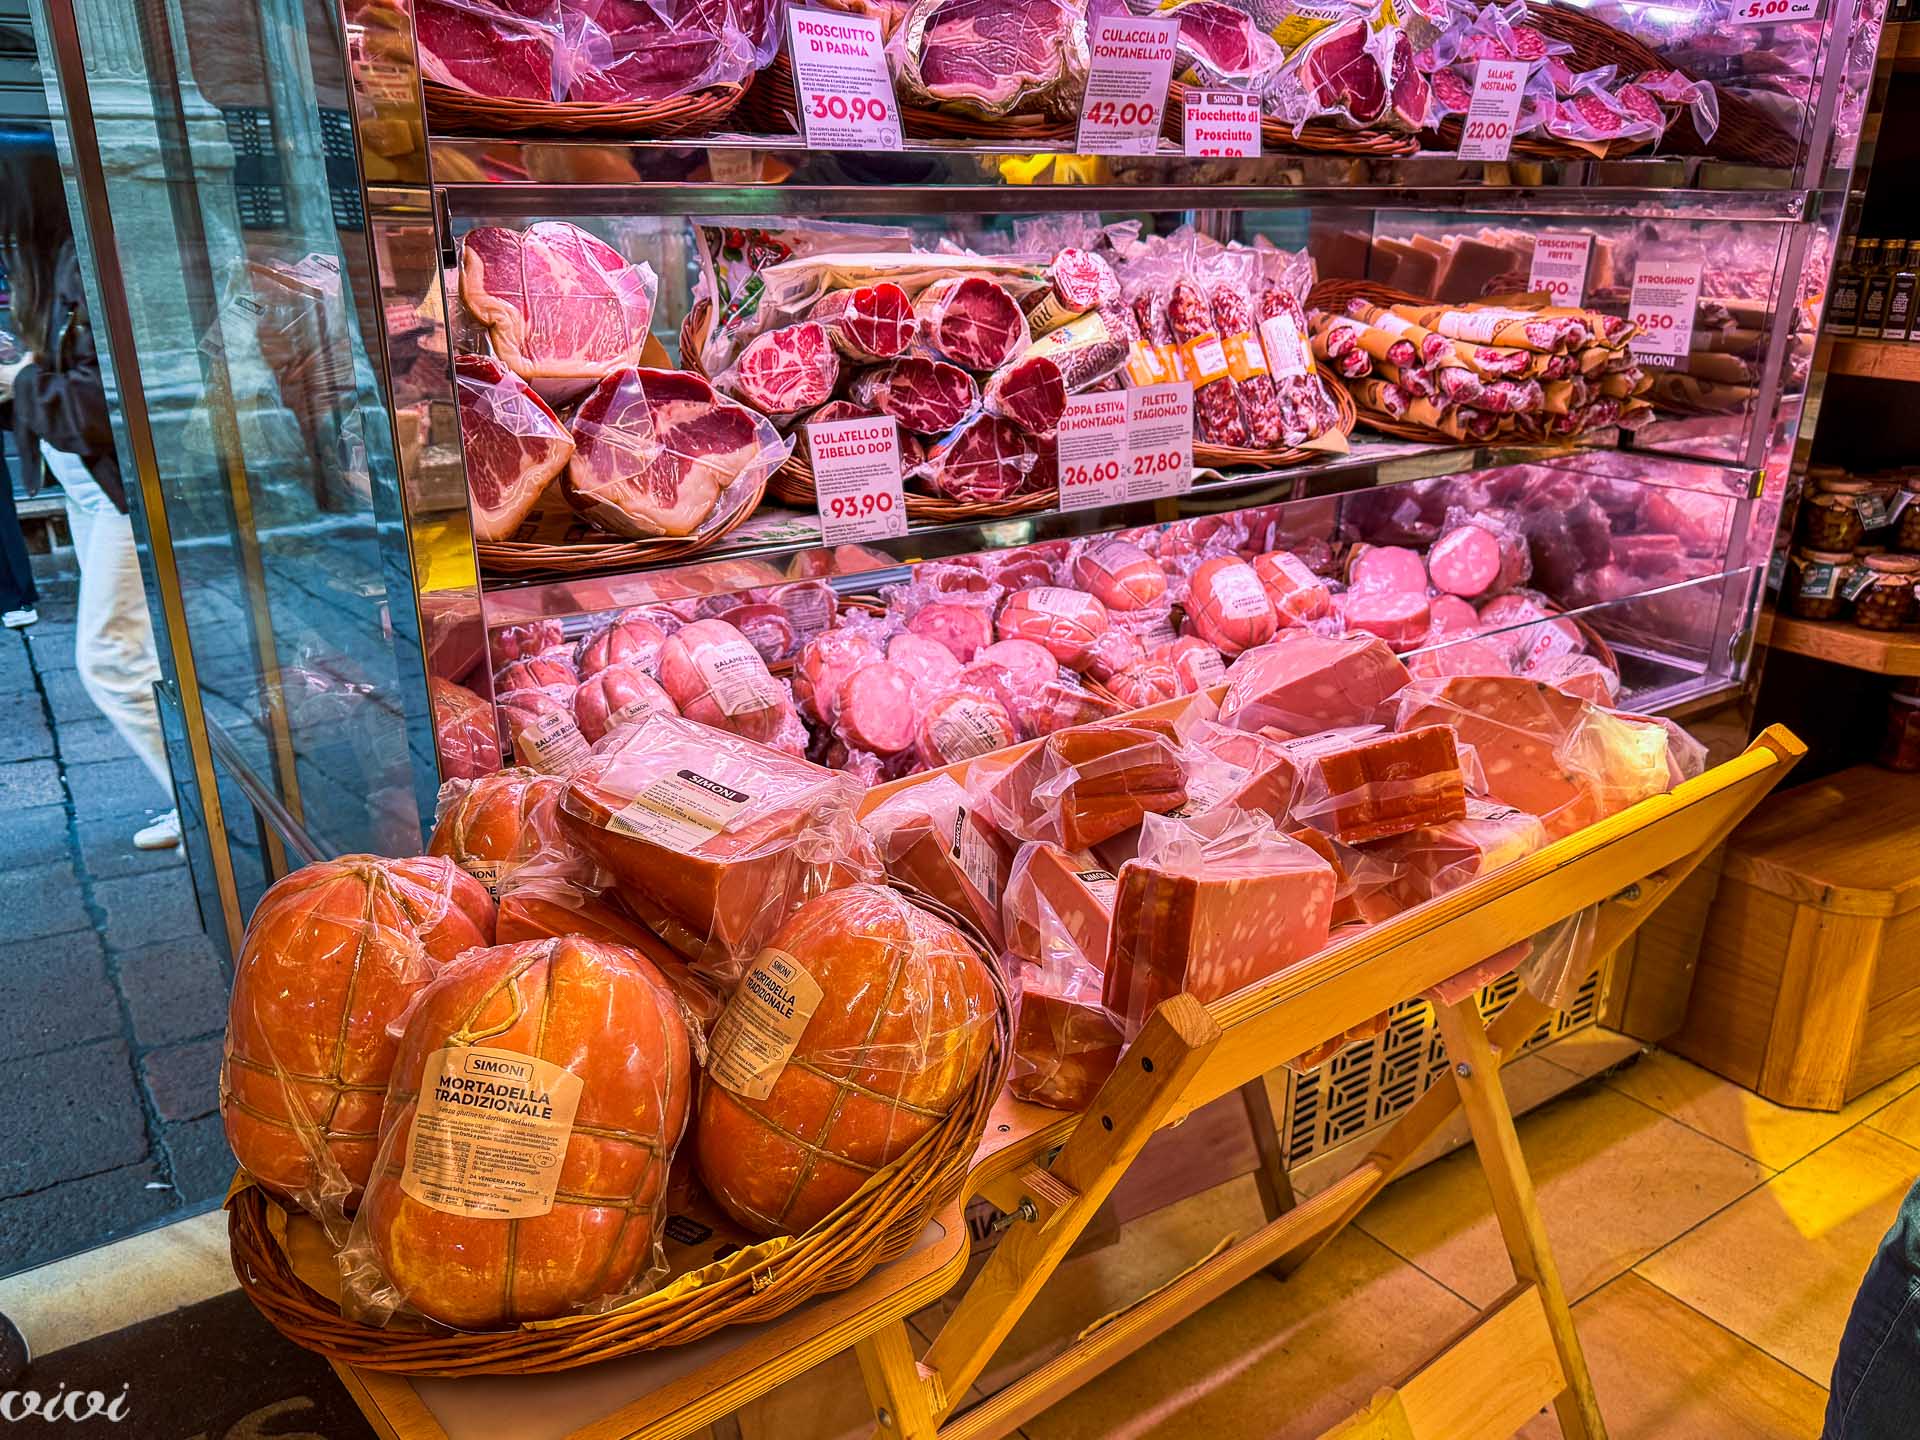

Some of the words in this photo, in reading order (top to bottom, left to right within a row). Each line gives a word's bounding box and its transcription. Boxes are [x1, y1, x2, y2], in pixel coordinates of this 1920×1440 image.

[1747, 1, 1789, 18] 5,00
[798, 20, 875, 42] PROSCIUTTO
[1102, 28, 1155, 44] CULACCIA
[1158, 31, 1168, 44] DI
[810, 39, 824, 52] DI
[826, 42, 869, 57] PARMA
[1094, 45, 1172, 61] FONTANELLATO
[811, 94, 887, 123] 30,90
[1213, 95, 1238, 105] SIMONI
[1087, 101, 1154, 128] 42,00
[1187, 108, 1247, 122] Fiocchetto
[1248, 110, 1258, 122] di
[1195, 128, 1252, 141] Prosciutto
[1467, 121, 1508, 142] 22,00
[1637, 275, 1695, 285] STROLGHINO
[1636, 313, 1673, 329] 9,50
[1095, 401, 1125, 415] ESTIVA
[1142, 393, 1178, 407] FILETTO
[1133, 405, 1189, 421] STAGIONATO
[1060, 421, 1070, 432] DI
[1072, 414, 1126, 431] MONTAGNA
[813, 428, 879, 446] CULATELLO
[881, 427, 894, 438] DI
[818, 444, 866, 460] ZIBELLO
[868, 441, 892, 454] DOP
[1134, 451, 1182, 477] 27,80
[1065, 461, 1119, 487] 26,60
[830, 492, 893, 519] 93,90
[713, 656, 744, 669] SALAME
[539, 715, 561, 730] SIMONI
[534, 730, 561, 748] SALAME
[689, 775, 737, 801] SIMONI
[773, 959, 792, 978] SIMONI
[751, 967, 796, 1006] MORTADELLA
[746, 976, 794, 1019] TRADIZIONALE
[473, 1059, 524, 1078] SIMONI
[439, 1074, 550, 1106] MORTADELLA
[434, 1087, 553, 1121] TRADIZIONALE
[511, 1180, 526, 1188] PESO
